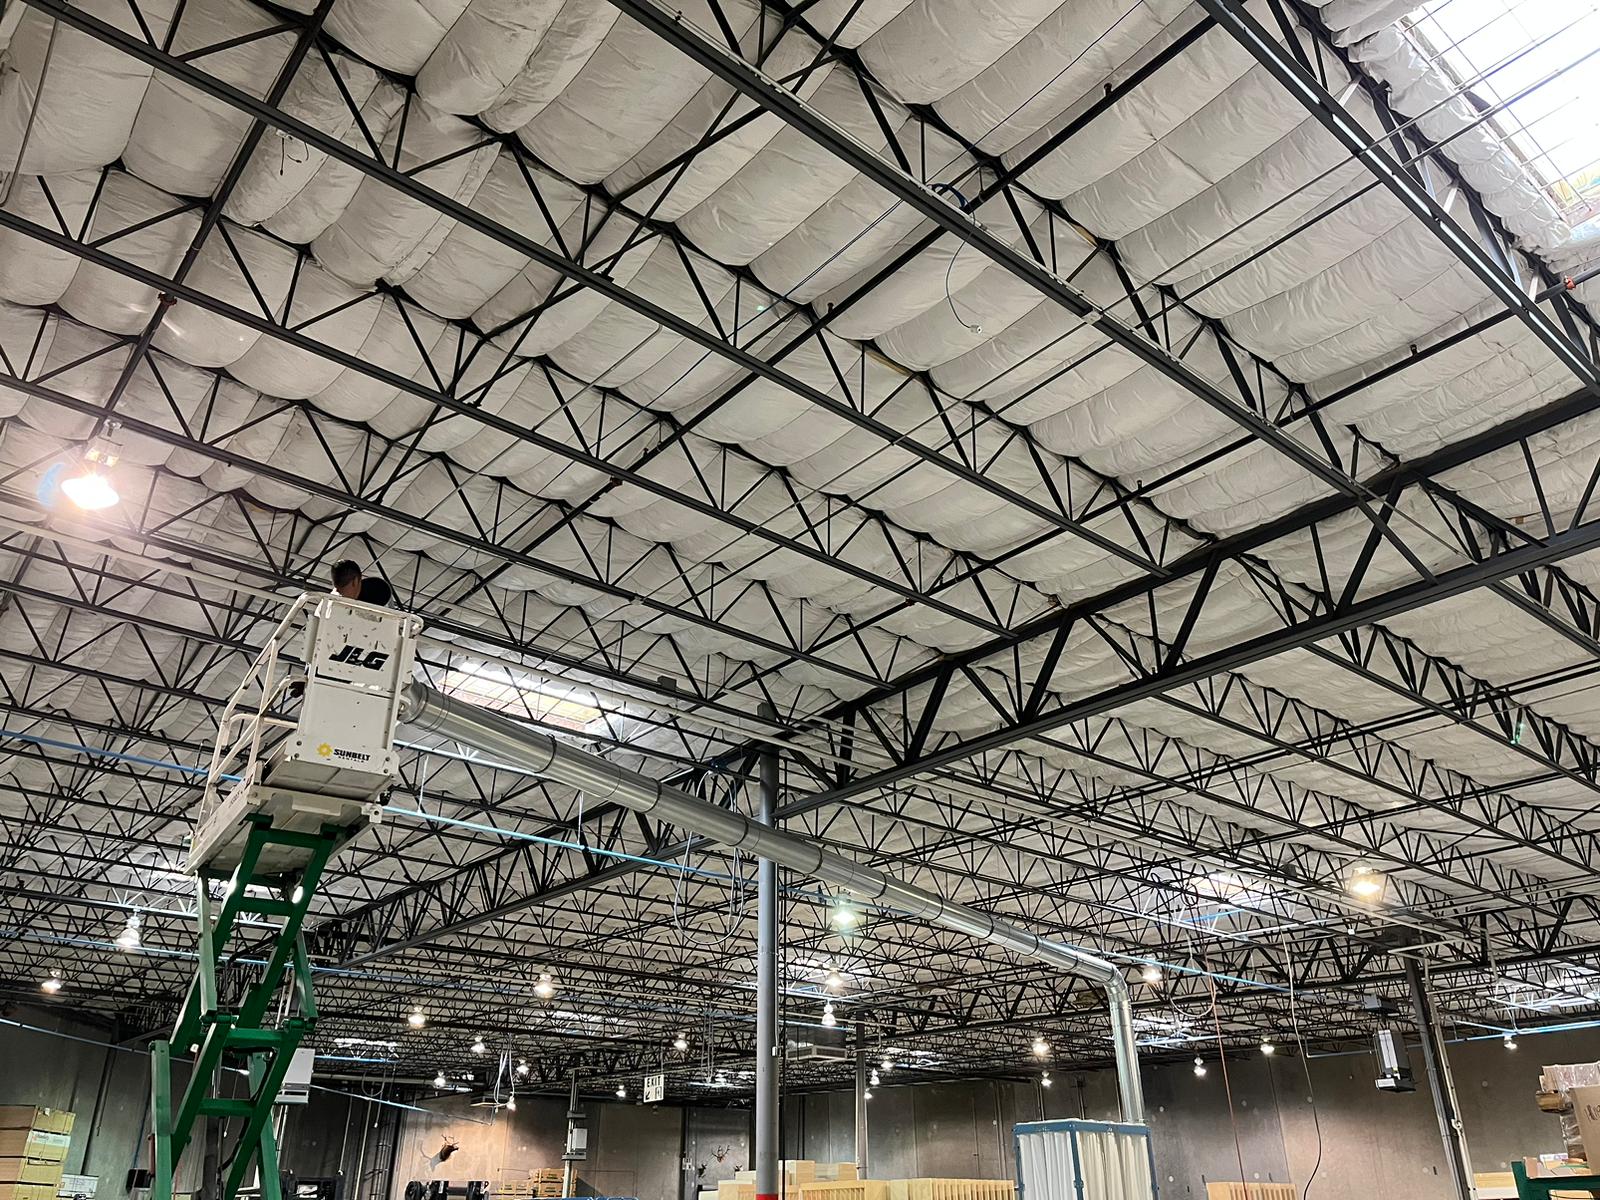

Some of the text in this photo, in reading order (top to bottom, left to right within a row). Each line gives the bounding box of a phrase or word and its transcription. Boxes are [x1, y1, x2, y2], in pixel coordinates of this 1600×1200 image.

[329, 645, 389, 671] JLG
[333, 748, 370, 761] SUNBELT
[647, 1076, 661, 1087] EXIT
